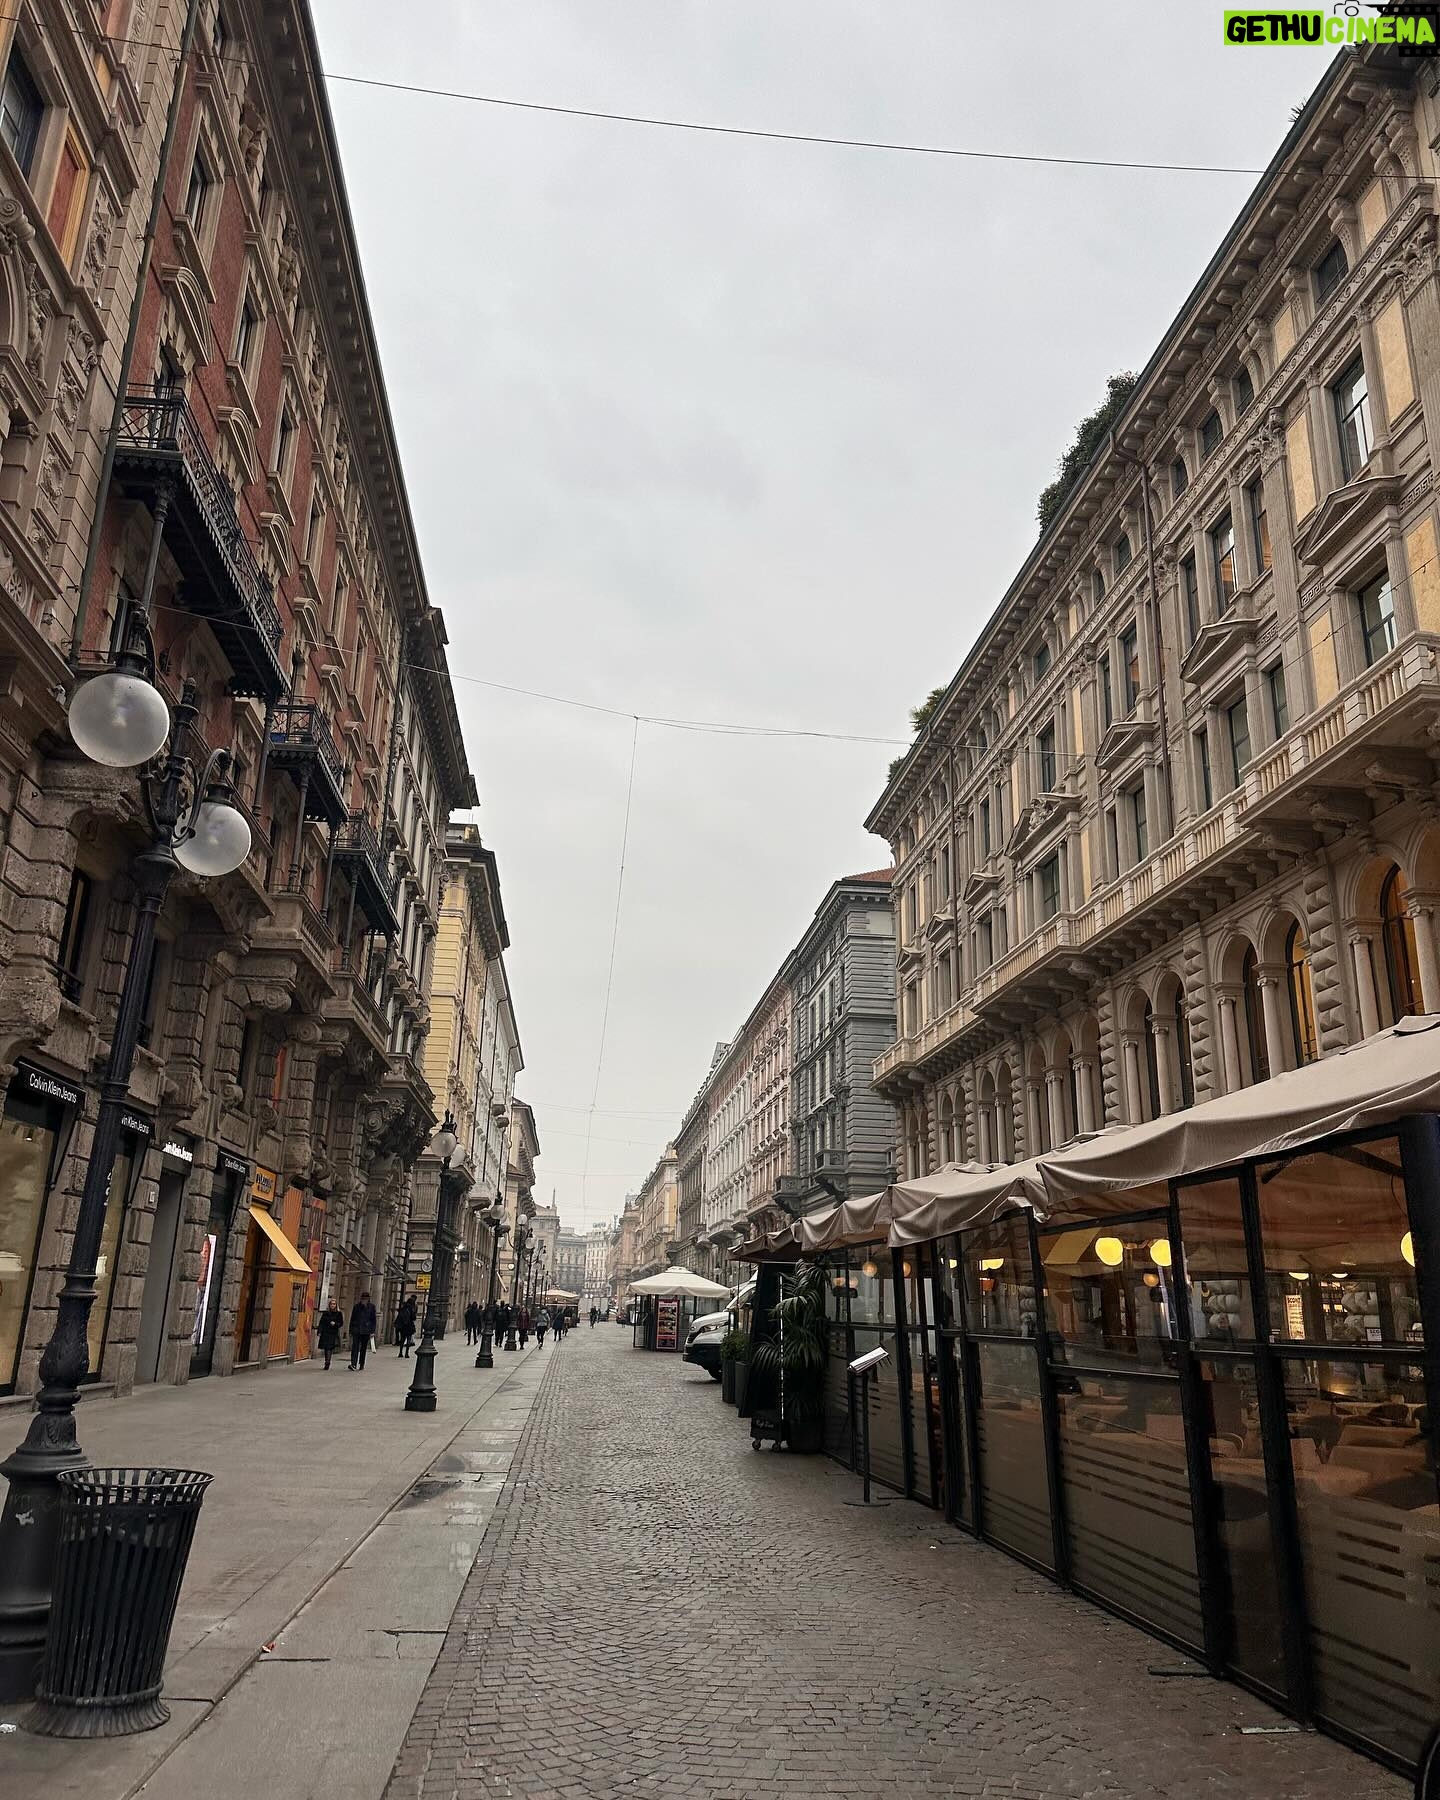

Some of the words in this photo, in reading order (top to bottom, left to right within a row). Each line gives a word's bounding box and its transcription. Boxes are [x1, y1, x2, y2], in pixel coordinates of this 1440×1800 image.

[29, 1073, 48, 1092] Calvin
[47, 1080, 62, 1097] Klein
[61, 1086, 77, 1103] Jeans
